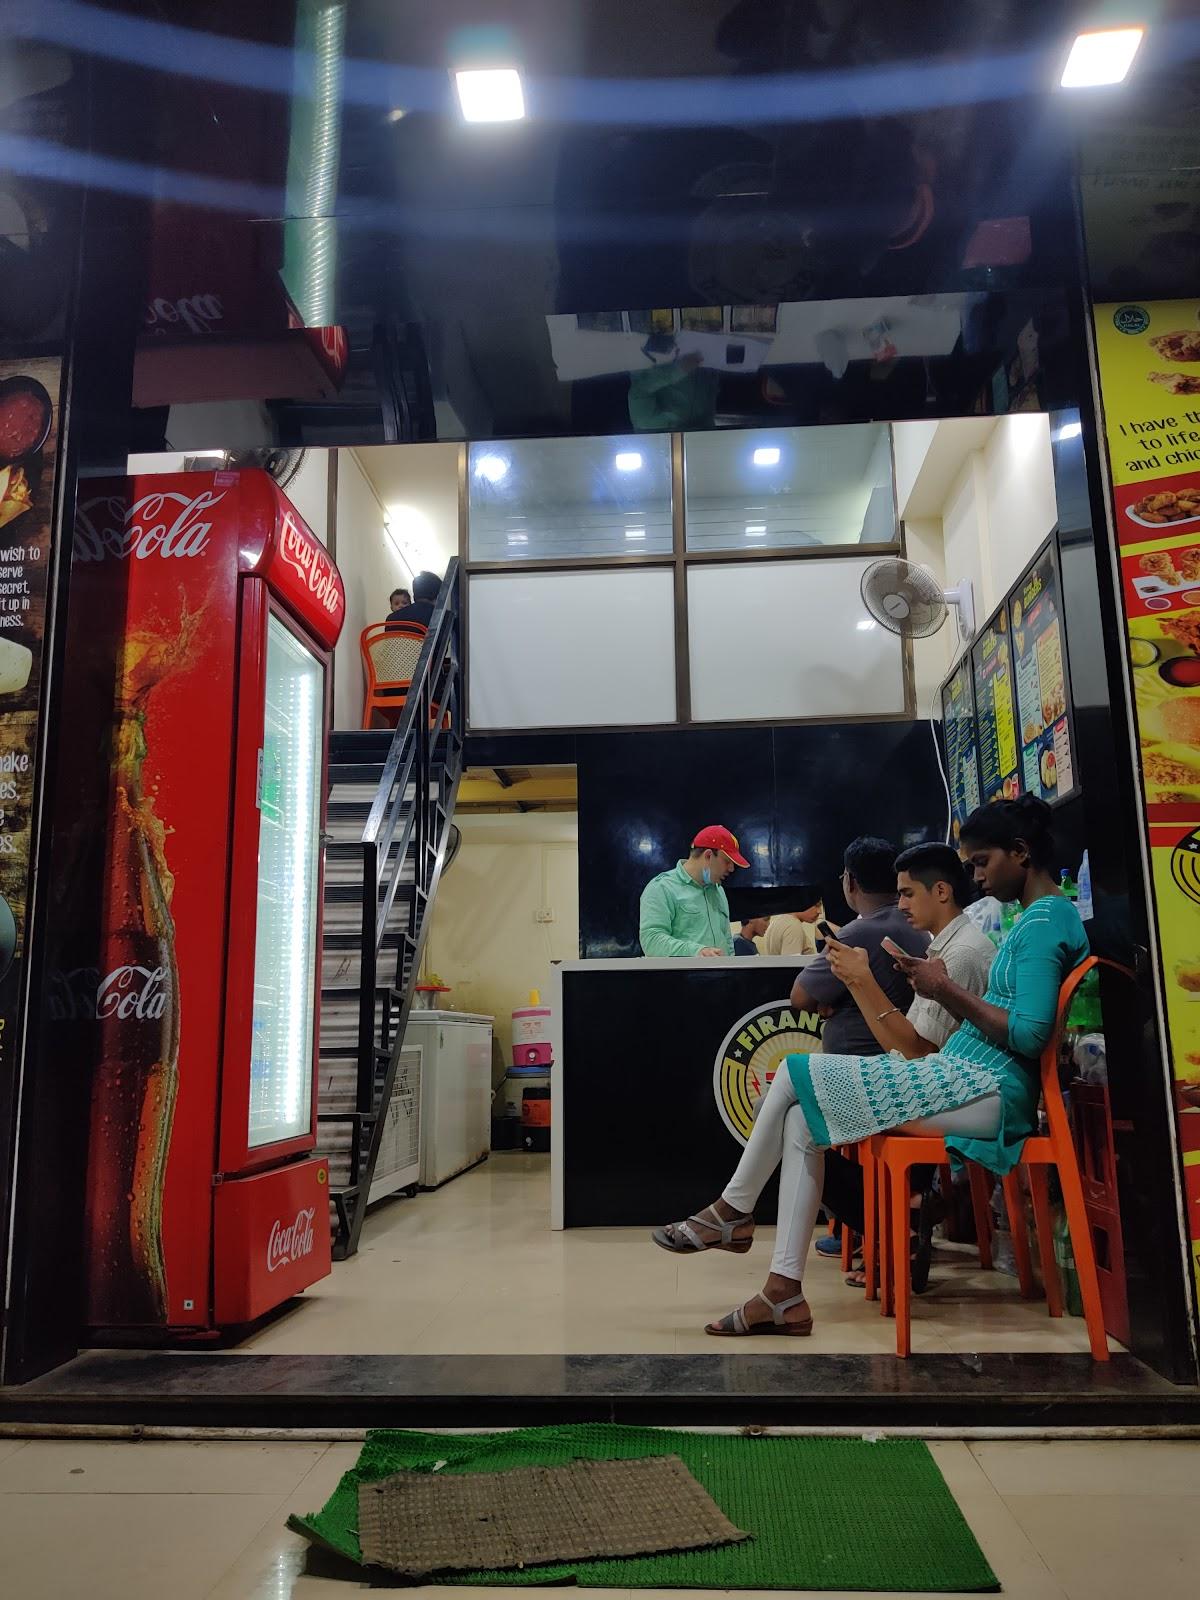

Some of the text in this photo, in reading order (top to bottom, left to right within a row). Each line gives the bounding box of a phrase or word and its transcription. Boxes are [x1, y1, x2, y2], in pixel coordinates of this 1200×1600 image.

[1119, 424, 1127, 436] I
[1130, 417, 1178, 434] have
[1137, 431, 1200, 450] to life
[1126, 455, 1161, 471] and
[0, 546, 40, 561] wish to
[280, 511, 339, 614] Coca-Cola
[9, 598, 20, 612] up
[22, 596, 30, 610] in
[736, 1009, 826, 1051] FIRAN
[267, 1207, 316, 1273] Coca-Cola
